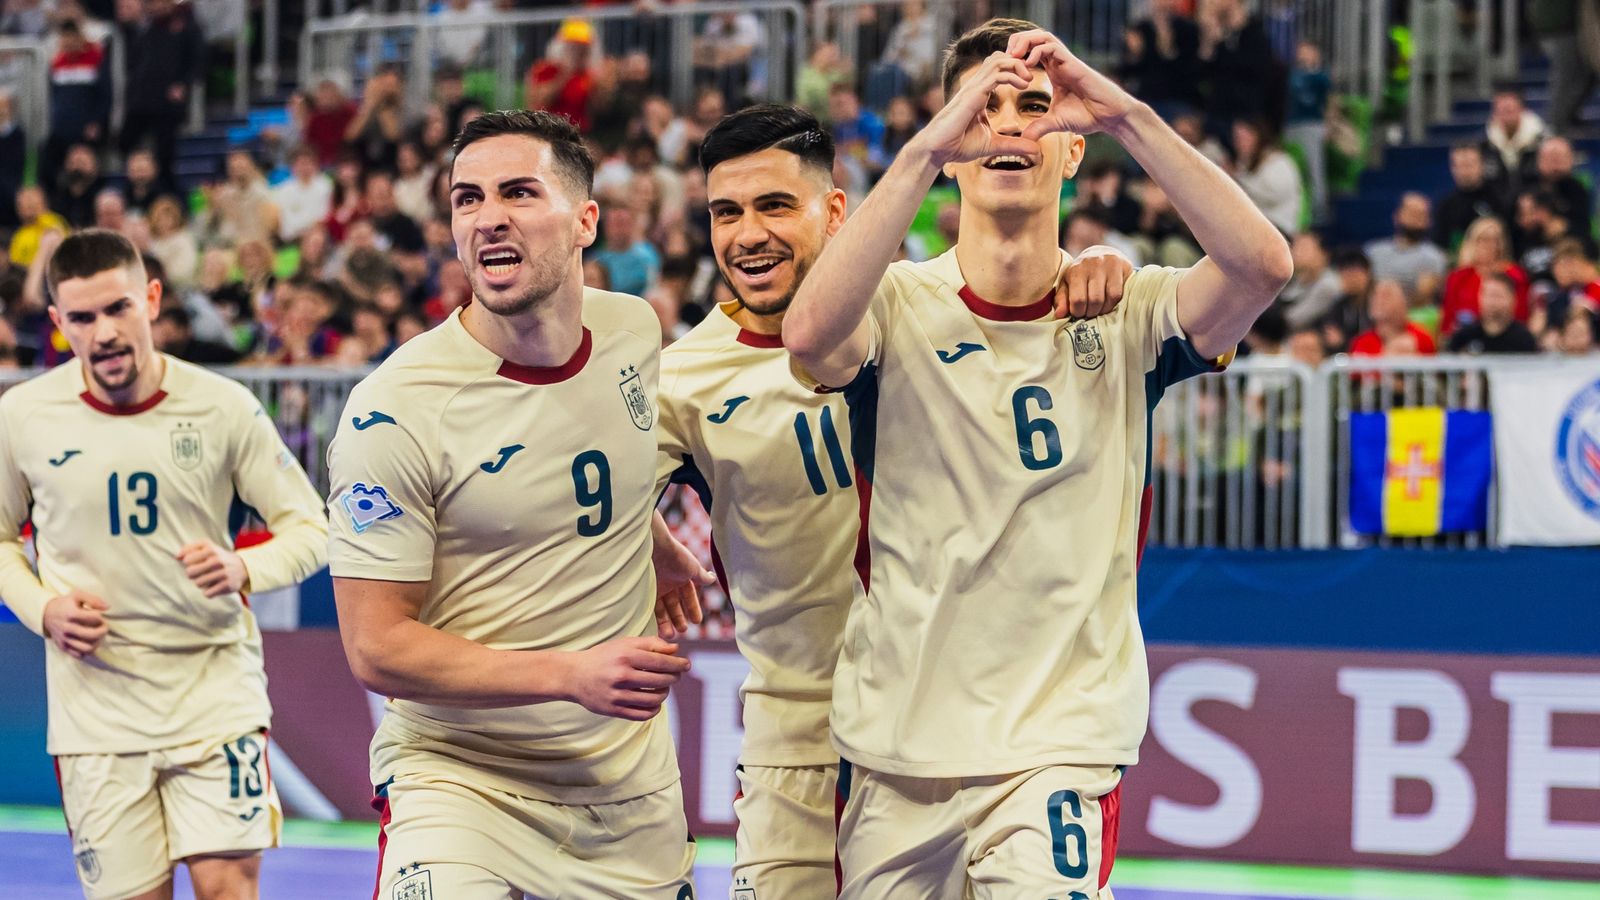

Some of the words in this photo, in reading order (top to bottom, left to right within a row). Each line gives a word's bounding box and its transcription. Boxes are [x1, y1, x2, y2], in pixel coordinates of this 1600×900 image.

[793, 405, 853, 496] 11
[1012, 385, 1063, 471] 6
[108, 471, 158, 537] 13
[571, 449, 613, 537] 9
[223, 735, 263, 798] 13
[1337, 667, 1600, 864] BE
[1047, 789, 1089, 879] 6
